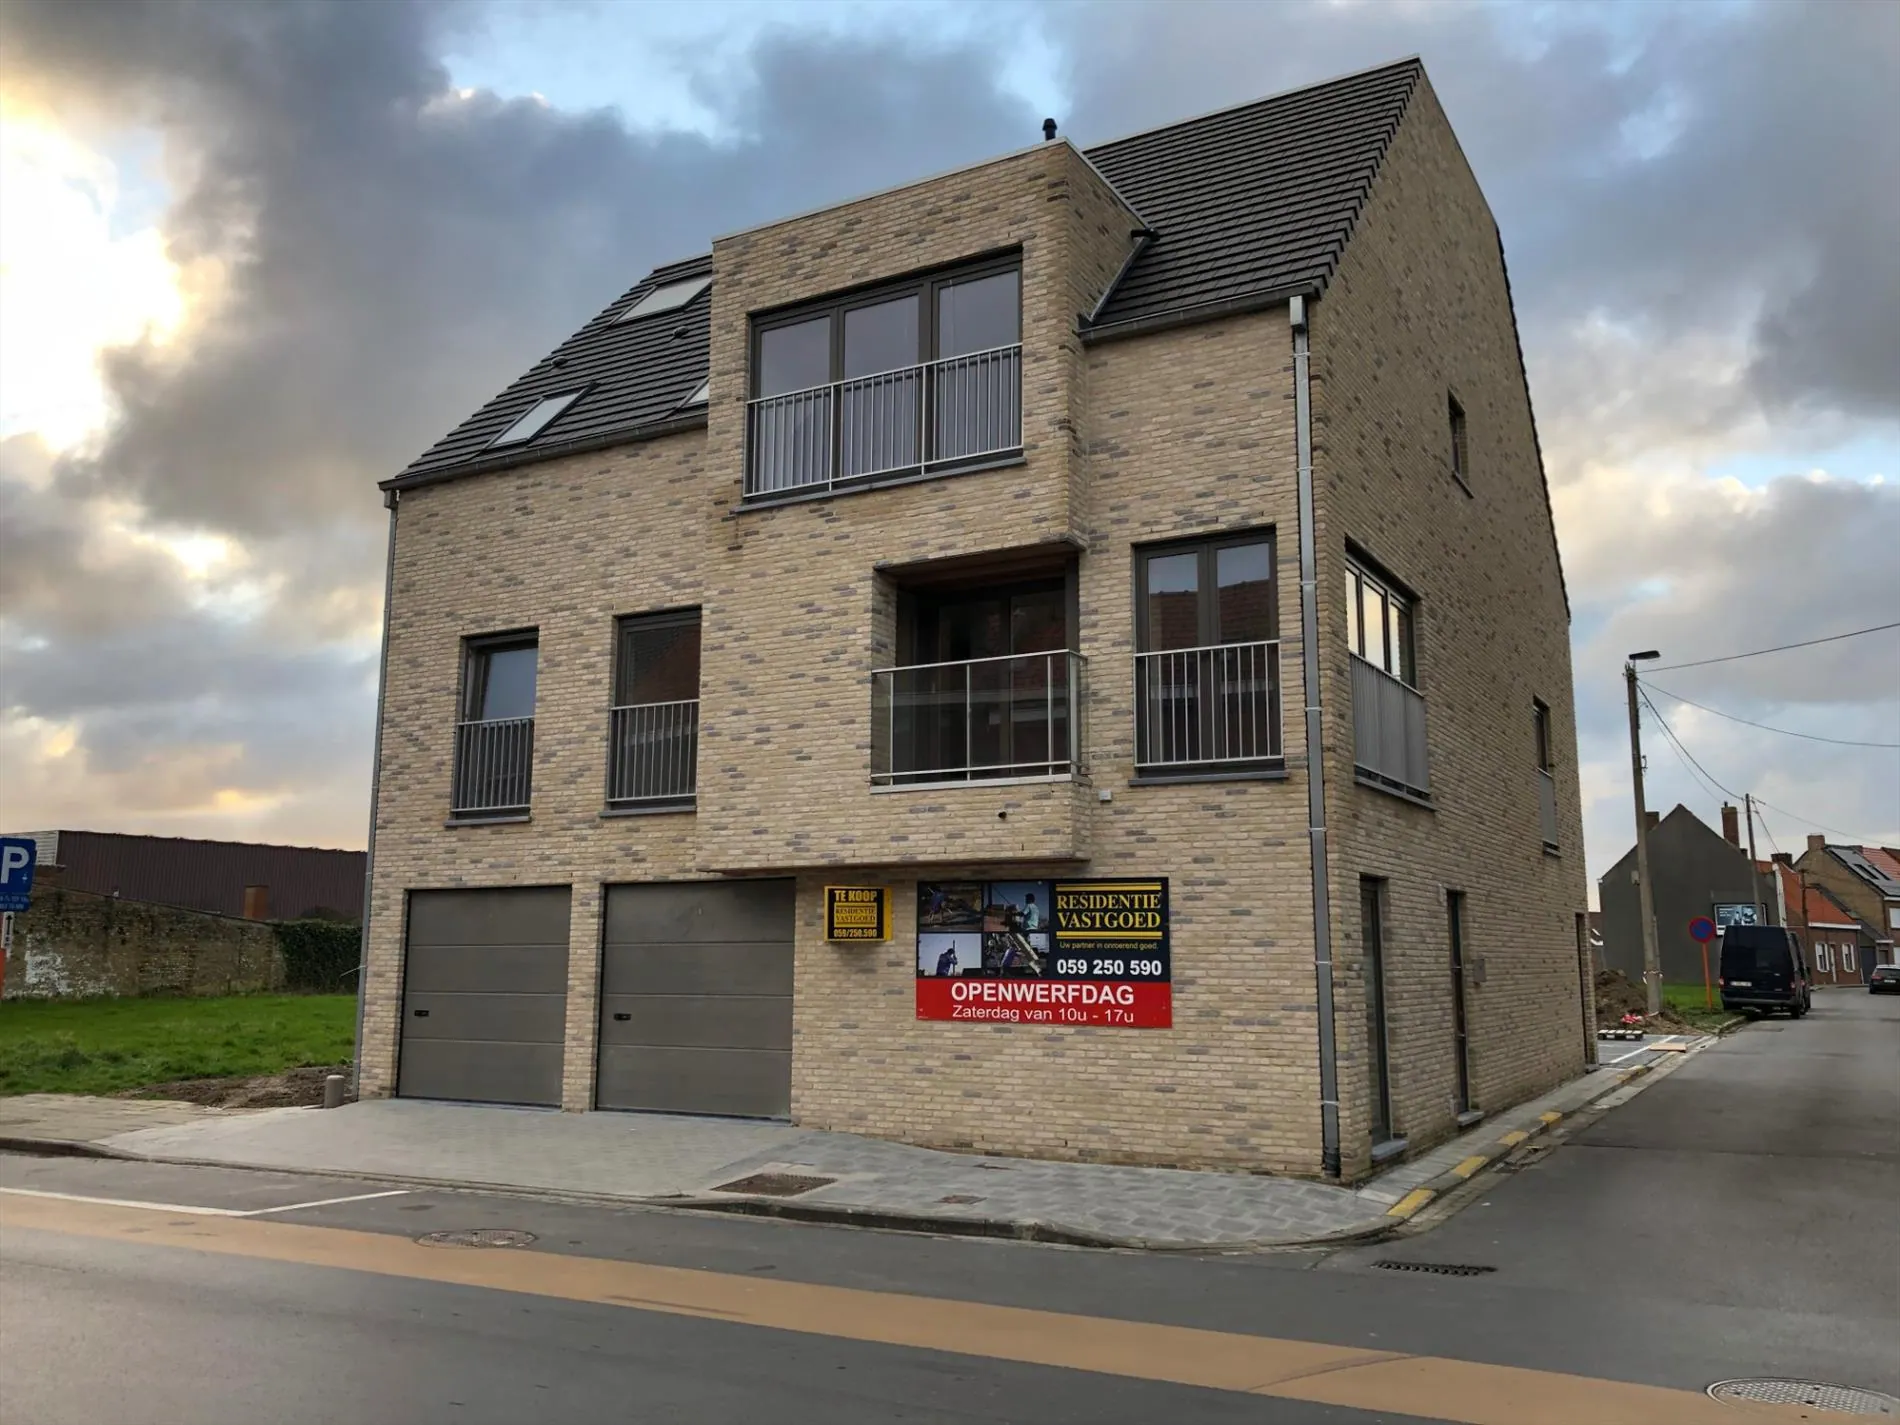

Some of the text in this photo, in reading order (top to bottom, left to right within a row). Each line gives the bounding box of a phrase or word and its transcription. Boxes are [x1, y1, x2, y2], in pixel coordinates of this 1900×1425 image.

[0, 846, 29, 884] P
[834, 890, 878, 902] TE KOOP
[1056, 893, 1161, 910] RESIDENTIE
[1057, 911, 1161, 929] VASTGOED
[1072, 942, 1095, 950] partner
[1139, 942, 1159, 950] goed.
[1057, 959, 1162, 975] 059 250 590
[951, 982, 1134, 1005] OPENWERFDAG
[952, 1005, 1019, 1022] Zaterdag
[1025, 1009, 1052, 1021] van
[1059, 1008, 1087, 1021] 10u
[1105, 1009, 1134, 1022] 17u
